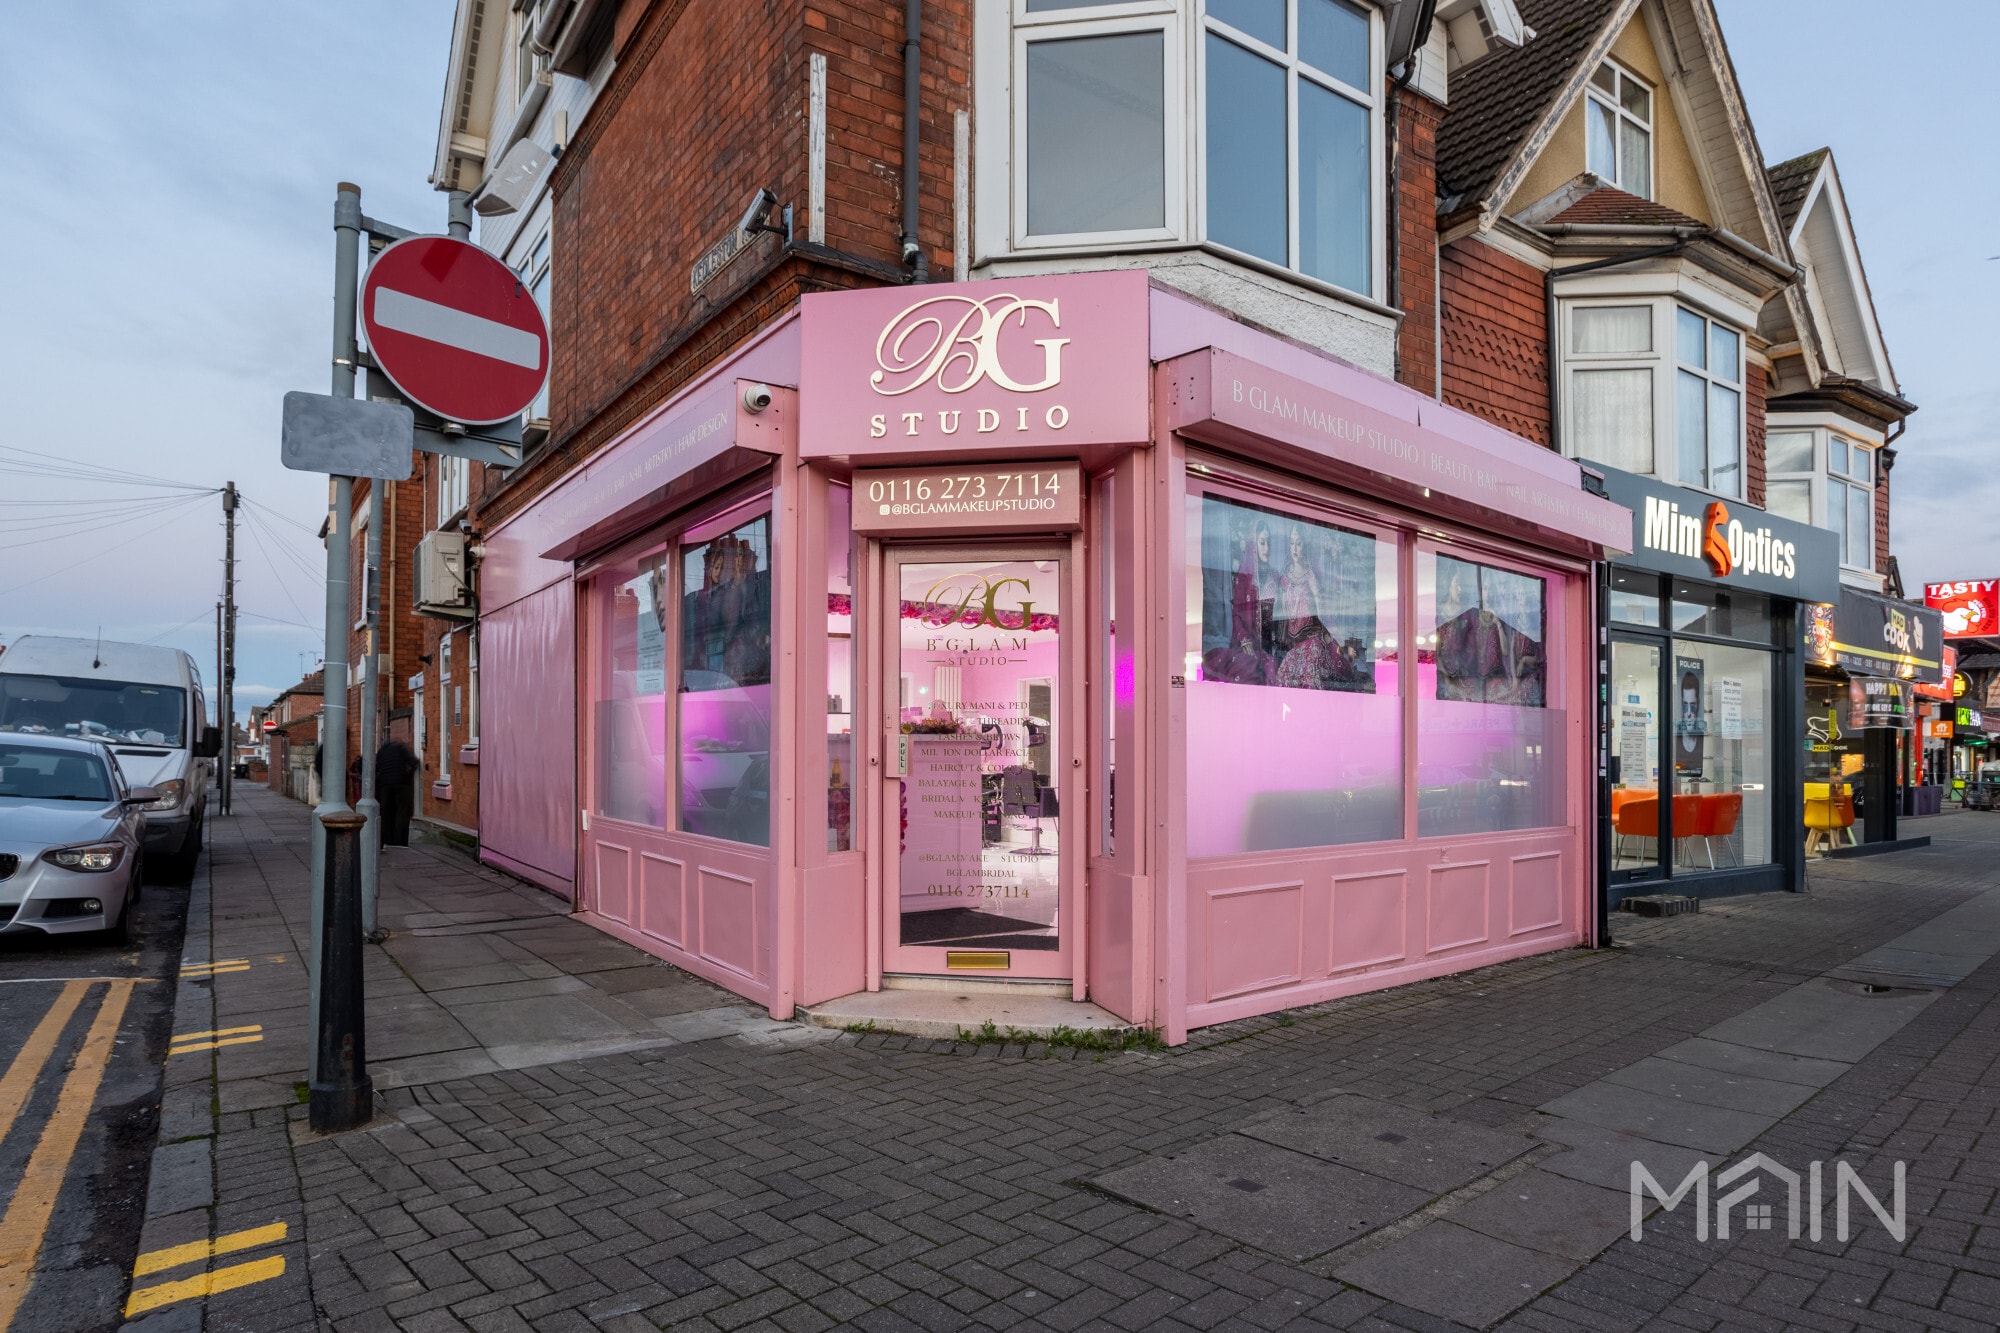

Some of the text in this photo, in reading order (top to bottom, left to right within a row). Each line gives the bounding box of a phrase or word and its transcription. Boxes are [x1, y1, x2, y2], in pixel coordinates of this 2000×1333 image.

[870, 293, 1071, 396] BG
[870, 405, 1069, 438] STUDIO
[644, 447, 674, 473] ARTISTRY
[677, 430, 696, 453] HAIR
[697, 410, 728, 442] DESIGN
[1233, 379, 1243, 403] B
[1249, 386, 1298, 423] GLAM
[1302, 407, 1364, 444] MAKEUP
[1368, 429, 1419, 465] STUDIO
[1431, 453, 1475, 484] BEAUTY
[1477, 469, 1497, 493] BAR
[1506, 485, 1528, 504] NAIL
[1531, 491, 1569, 518] ARTISTRY
[869, 473, 1061, 502] 0116 273 7114
[891, 497, 1055, 516] @BGLAMMAKEUPSTUDIO
[1644, 496, 1795, 579] Mim Optics
[1927, 580, 1996, 596] TASTY
[921, 573, 1036, 631] BG
[1891, 611, 1905, 629] MAD
[1883, 621, 1911, 653] COOK
[948, 656, 1007, 666] STUDIO
[1679, 660, 1701, 669] POLICE
[1865, 682, 1887, 695] HAPPY
[969, 701, 995, 710] MANI
[997, 701, 1006, 710] &
[975, 733, 984, 741] &
[964, 748, 1002, 757] DOLLAR
[930, 763, 974, 772] HAIRCUT
[976, 763, 984, 772] &
[918, 779, 967, 788] BALAYAGE
[969, 779, 977, 788] &
[921, 794, 956, 803] BRIDAL
[946, 868, 1017, 878] BGLAMBRIDAL
[927, 883, 1030, 899] 0116 2737114
